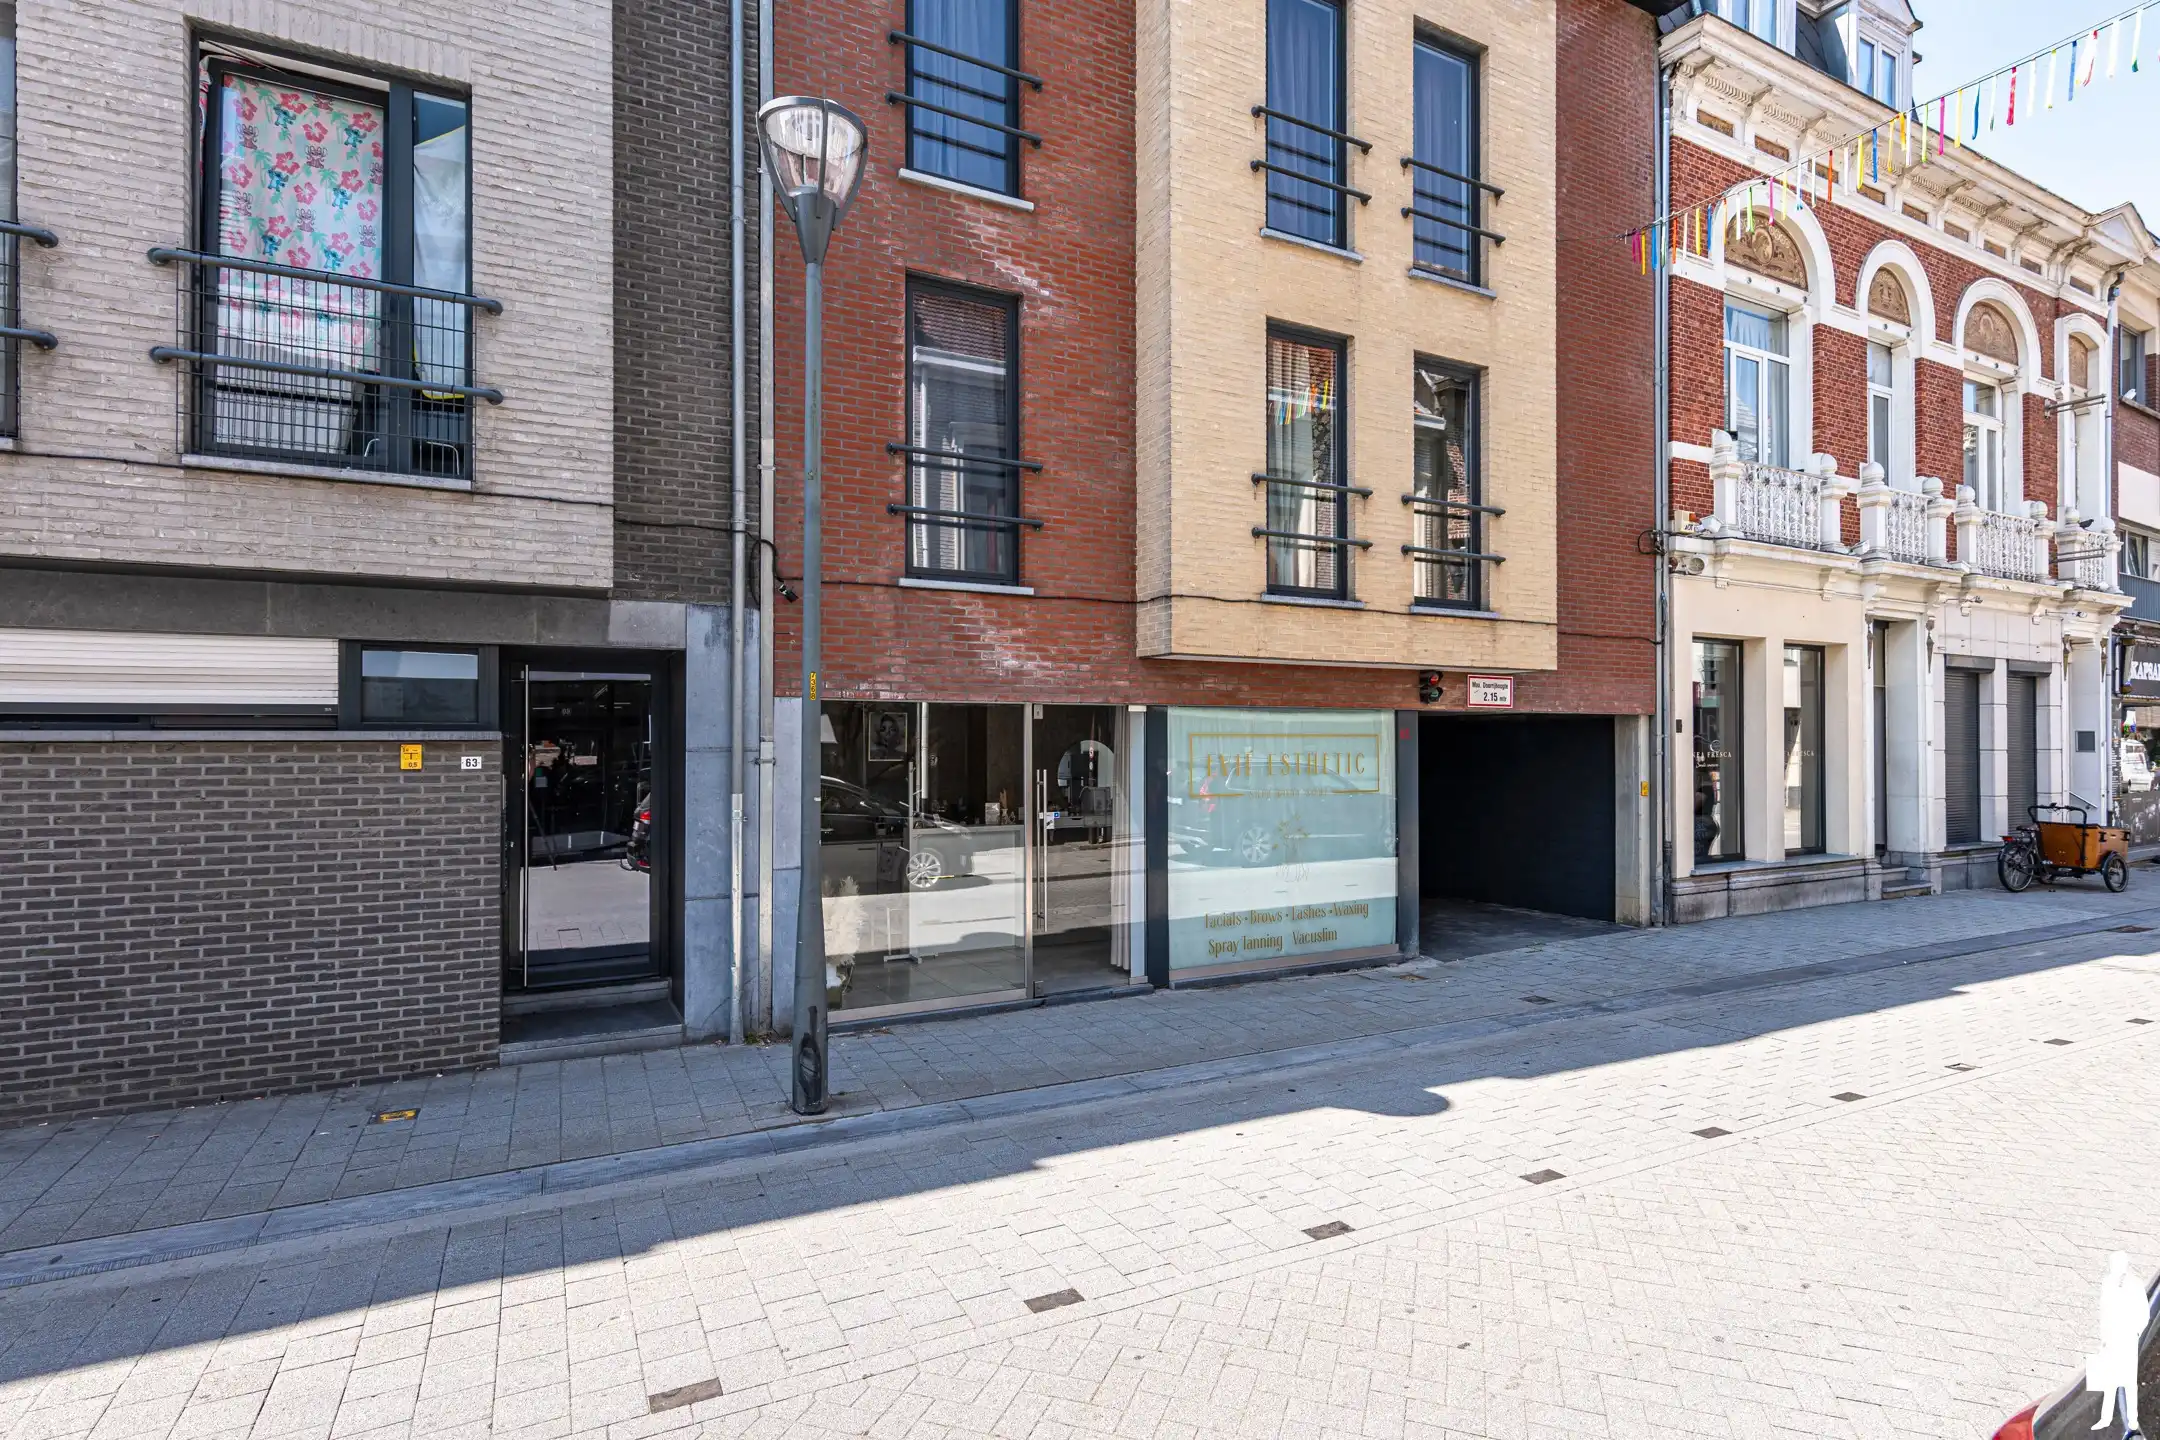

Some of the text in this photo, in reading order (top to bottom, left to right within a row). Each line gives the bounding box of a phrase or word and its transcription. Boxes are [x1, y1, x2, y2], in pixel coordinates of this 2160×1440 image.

[1484, 692, 1498, 701] 2.15
[408, 761, 418, 769] 0,5
[465, 758, 478, 767] 63
[1268, 752, 1365, 776] ESTHETIC
[1205, 901, 1368, 929] Facials Brows Lashes Waxing
[1208, 927, 1338, 958] Spray Tanning Vacuslim
